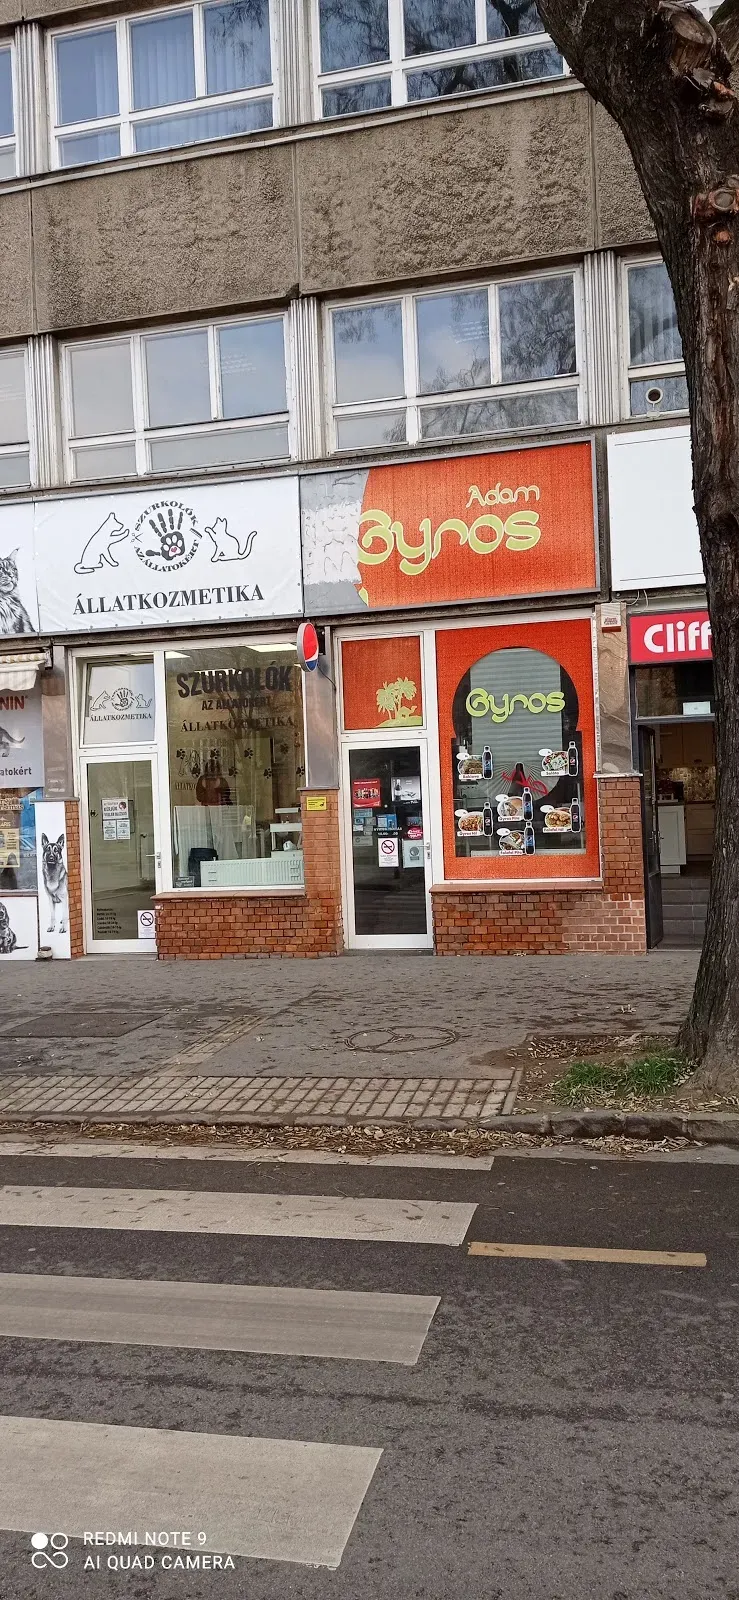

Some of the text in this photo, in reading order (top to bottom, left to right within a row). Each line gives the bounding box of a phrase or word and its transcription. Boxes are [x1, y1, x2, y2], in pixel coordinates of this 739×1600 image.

[135, 500, 199, 531] SZURKOLÓK
[357, 509, 542, 576] Gyros
[73, 584, 264, 615] ÁLLATKOZMETIKA
[176, 661, 292, 698] SZURKOLÓK
[90, 713, 152, 722] ÁLLATKOZMETIKA
[202, 700, 214, 710] AZ
[466, 688, 566, 723] Gyros
